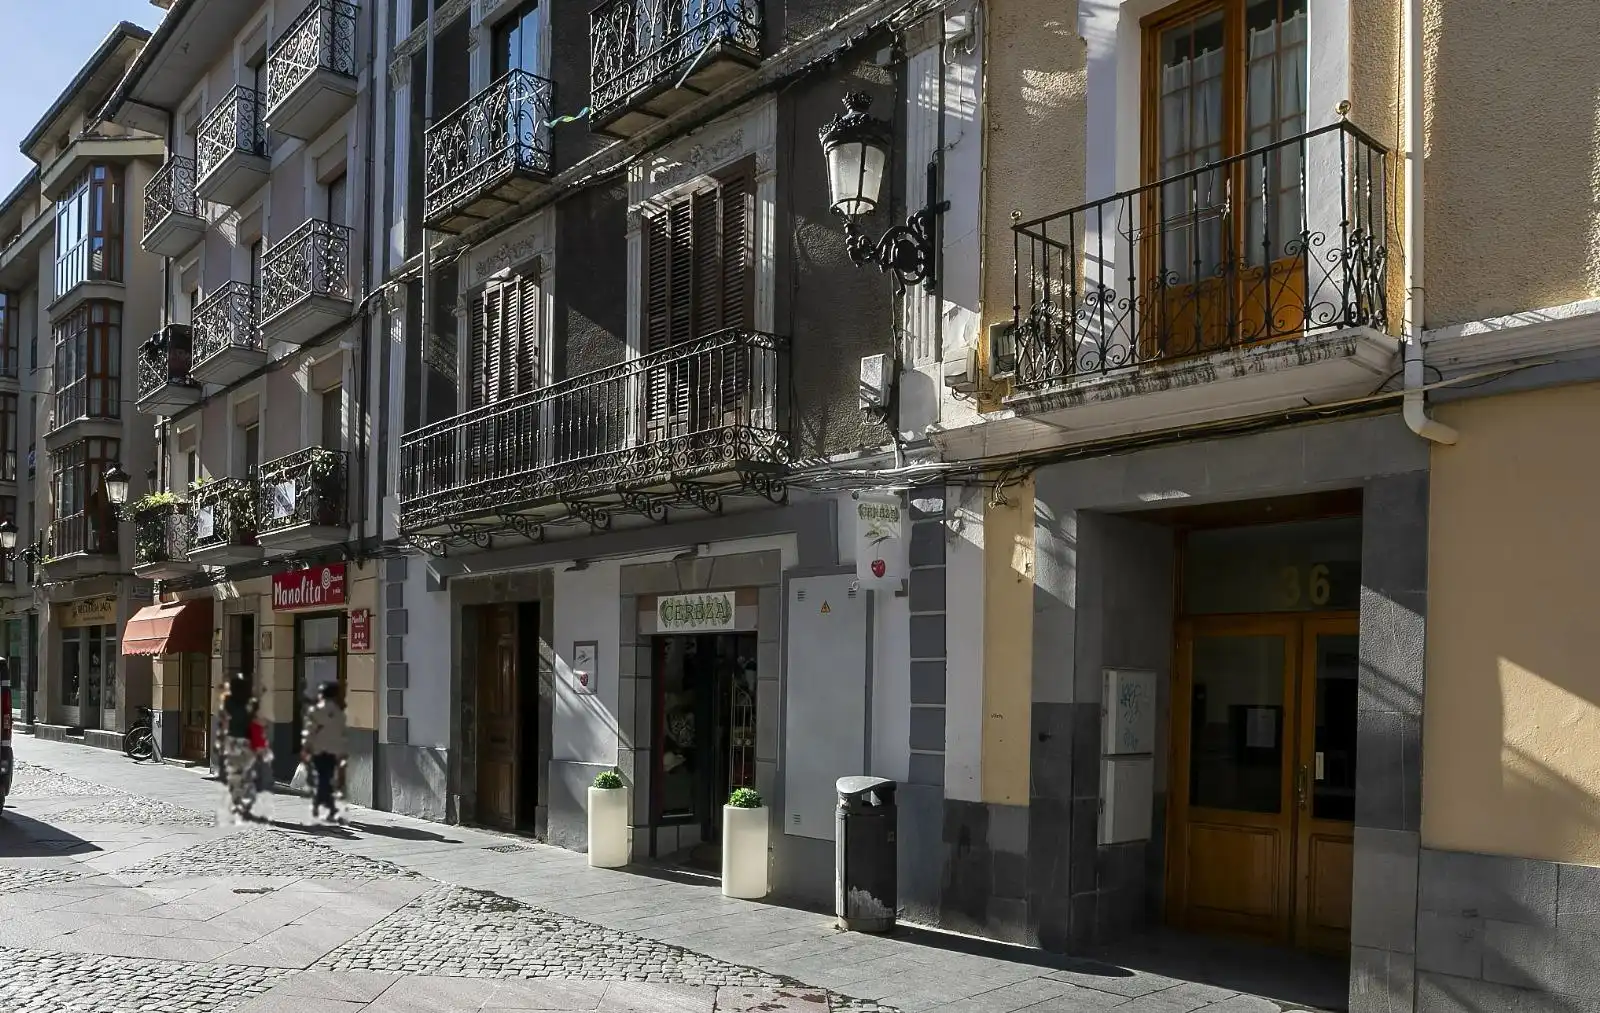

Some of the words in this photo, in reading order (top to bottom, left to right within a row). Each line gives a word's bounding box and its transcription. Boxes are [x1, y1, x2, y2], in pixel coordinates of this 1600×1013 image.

[274, 575, 321, 606] Manolita
[1280, 564, 1330, 607] 36
[664, 602, 727, 621] CEREZA
